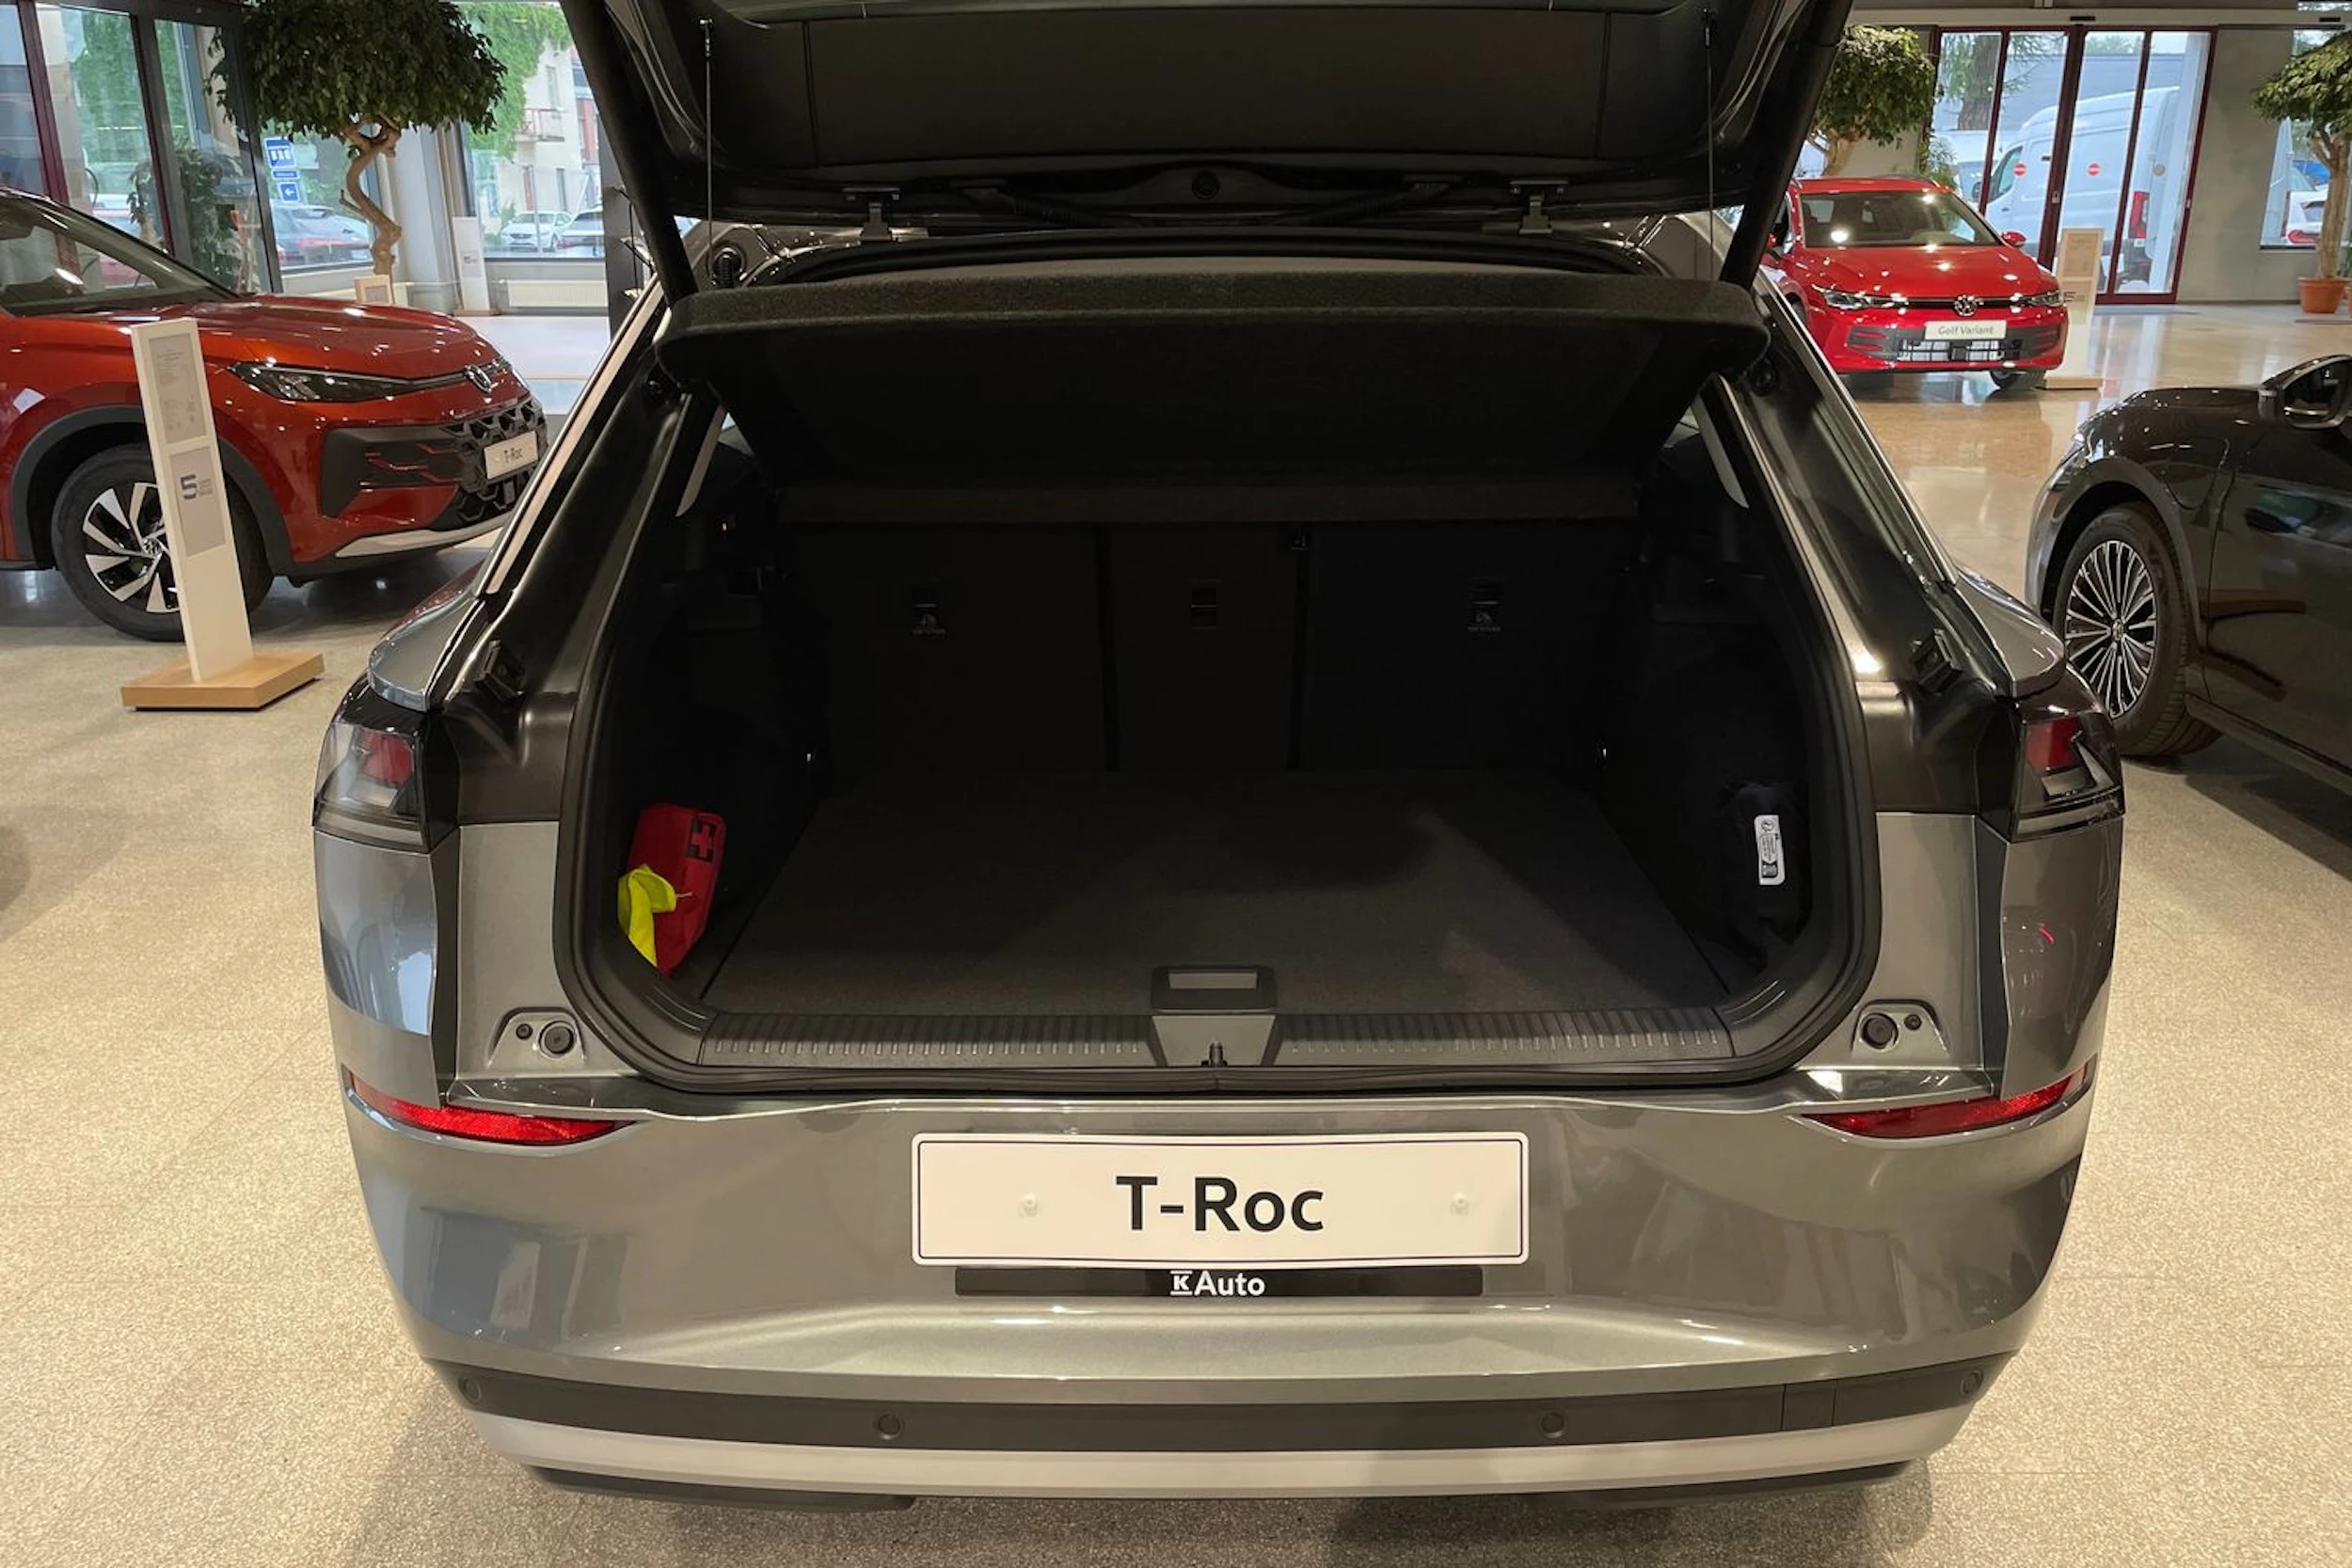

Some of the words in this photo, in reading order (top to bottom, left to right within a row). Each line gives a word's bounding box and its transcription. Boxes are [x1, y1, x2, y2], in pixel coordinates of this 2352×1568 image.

[1938, 325, 1959, 336] Golf
[1960, 325, 1994, 335] Variant
[180, 473, 197, 499] 5
[1116, 1176, 1324, 1232] T-Roc
